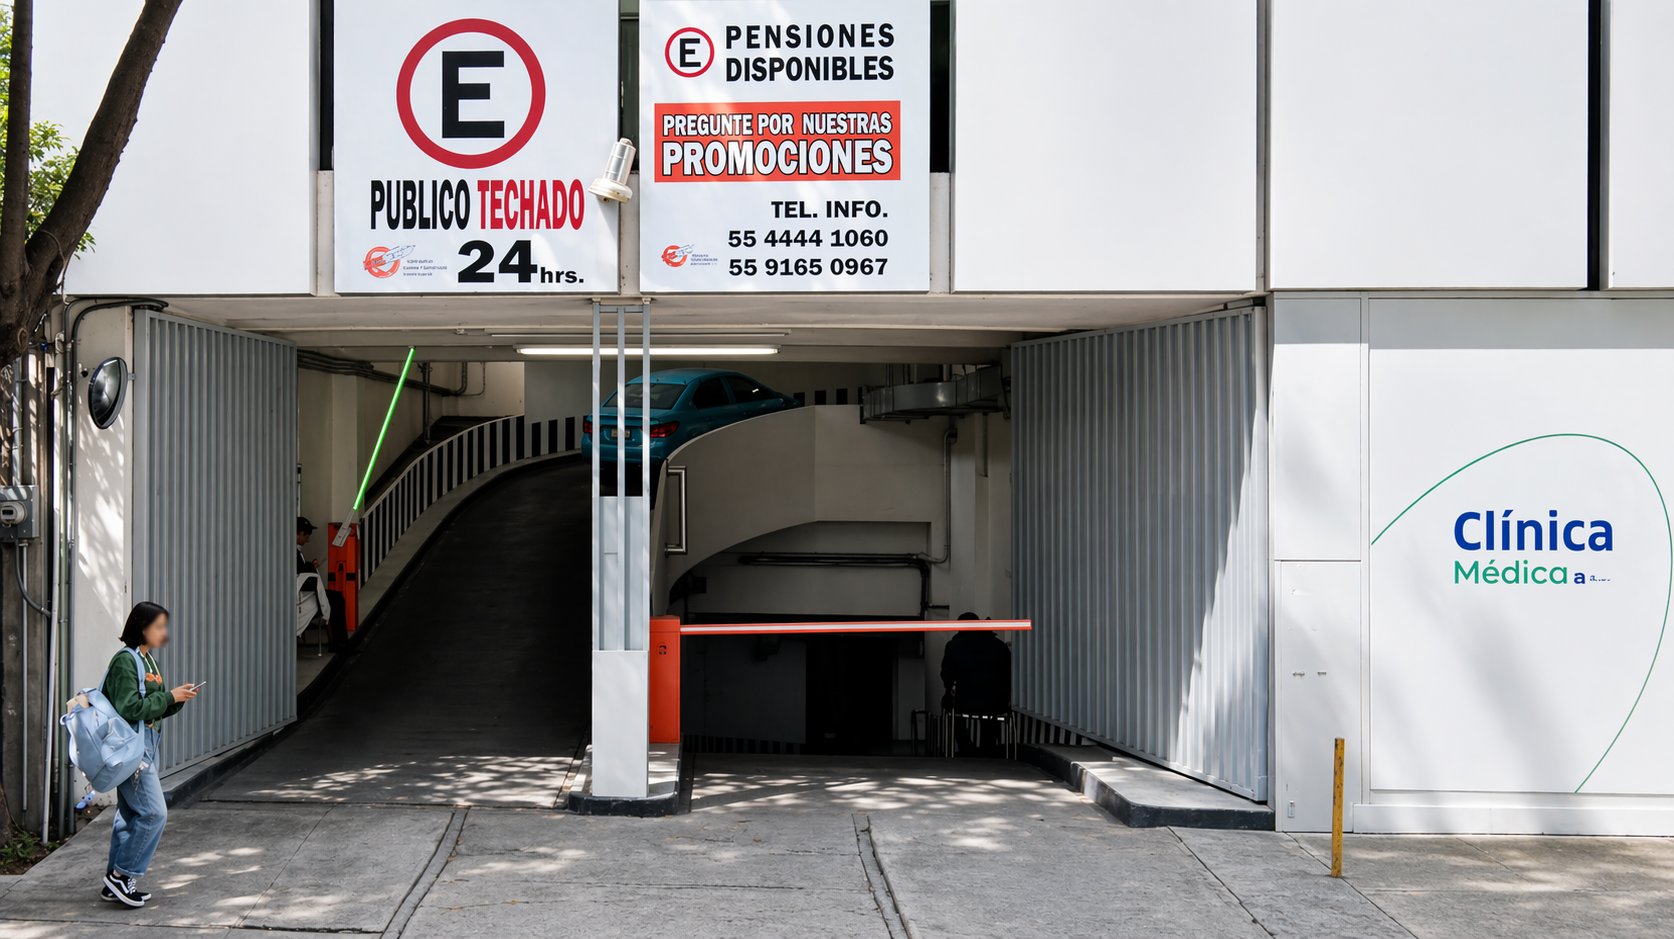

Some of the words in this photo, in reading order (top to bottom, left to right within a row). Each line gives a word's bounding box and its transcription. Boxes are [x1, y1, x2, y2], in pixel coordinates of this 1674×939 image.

[726, 23, 894, 49] PENSIONES
[679, 38, 701, 67] E
[726, 55, 894, 81] DISPONIBLES
[442, 51, 504, 138] E
[662, 113, 753, 136] PREGUNTE
[757, 113, 794, 136] POR
[802, 111, 893, 135] NUESTRAS
[661, 139, 893, 176] PROMOCIONES
[371, 179, 471, 230] PUBLICO
[477, 179, 585, 230] TECHADO
[771, 201, 818, 218] TEL.
[826, 200, 888, 218] INFO.
[728, 230, 757, 247] 55
[764, 229, 823, 247] 4444
[830, 229, 888, 247] 1060
[729, 259, 757, 276] 55
[765, 258, 822, 276] 9165
[830, 258, 888, 276] 0967
[1454, 510, 1613, 551] Clínica
[1454, 559, 1567, 584] Médica
